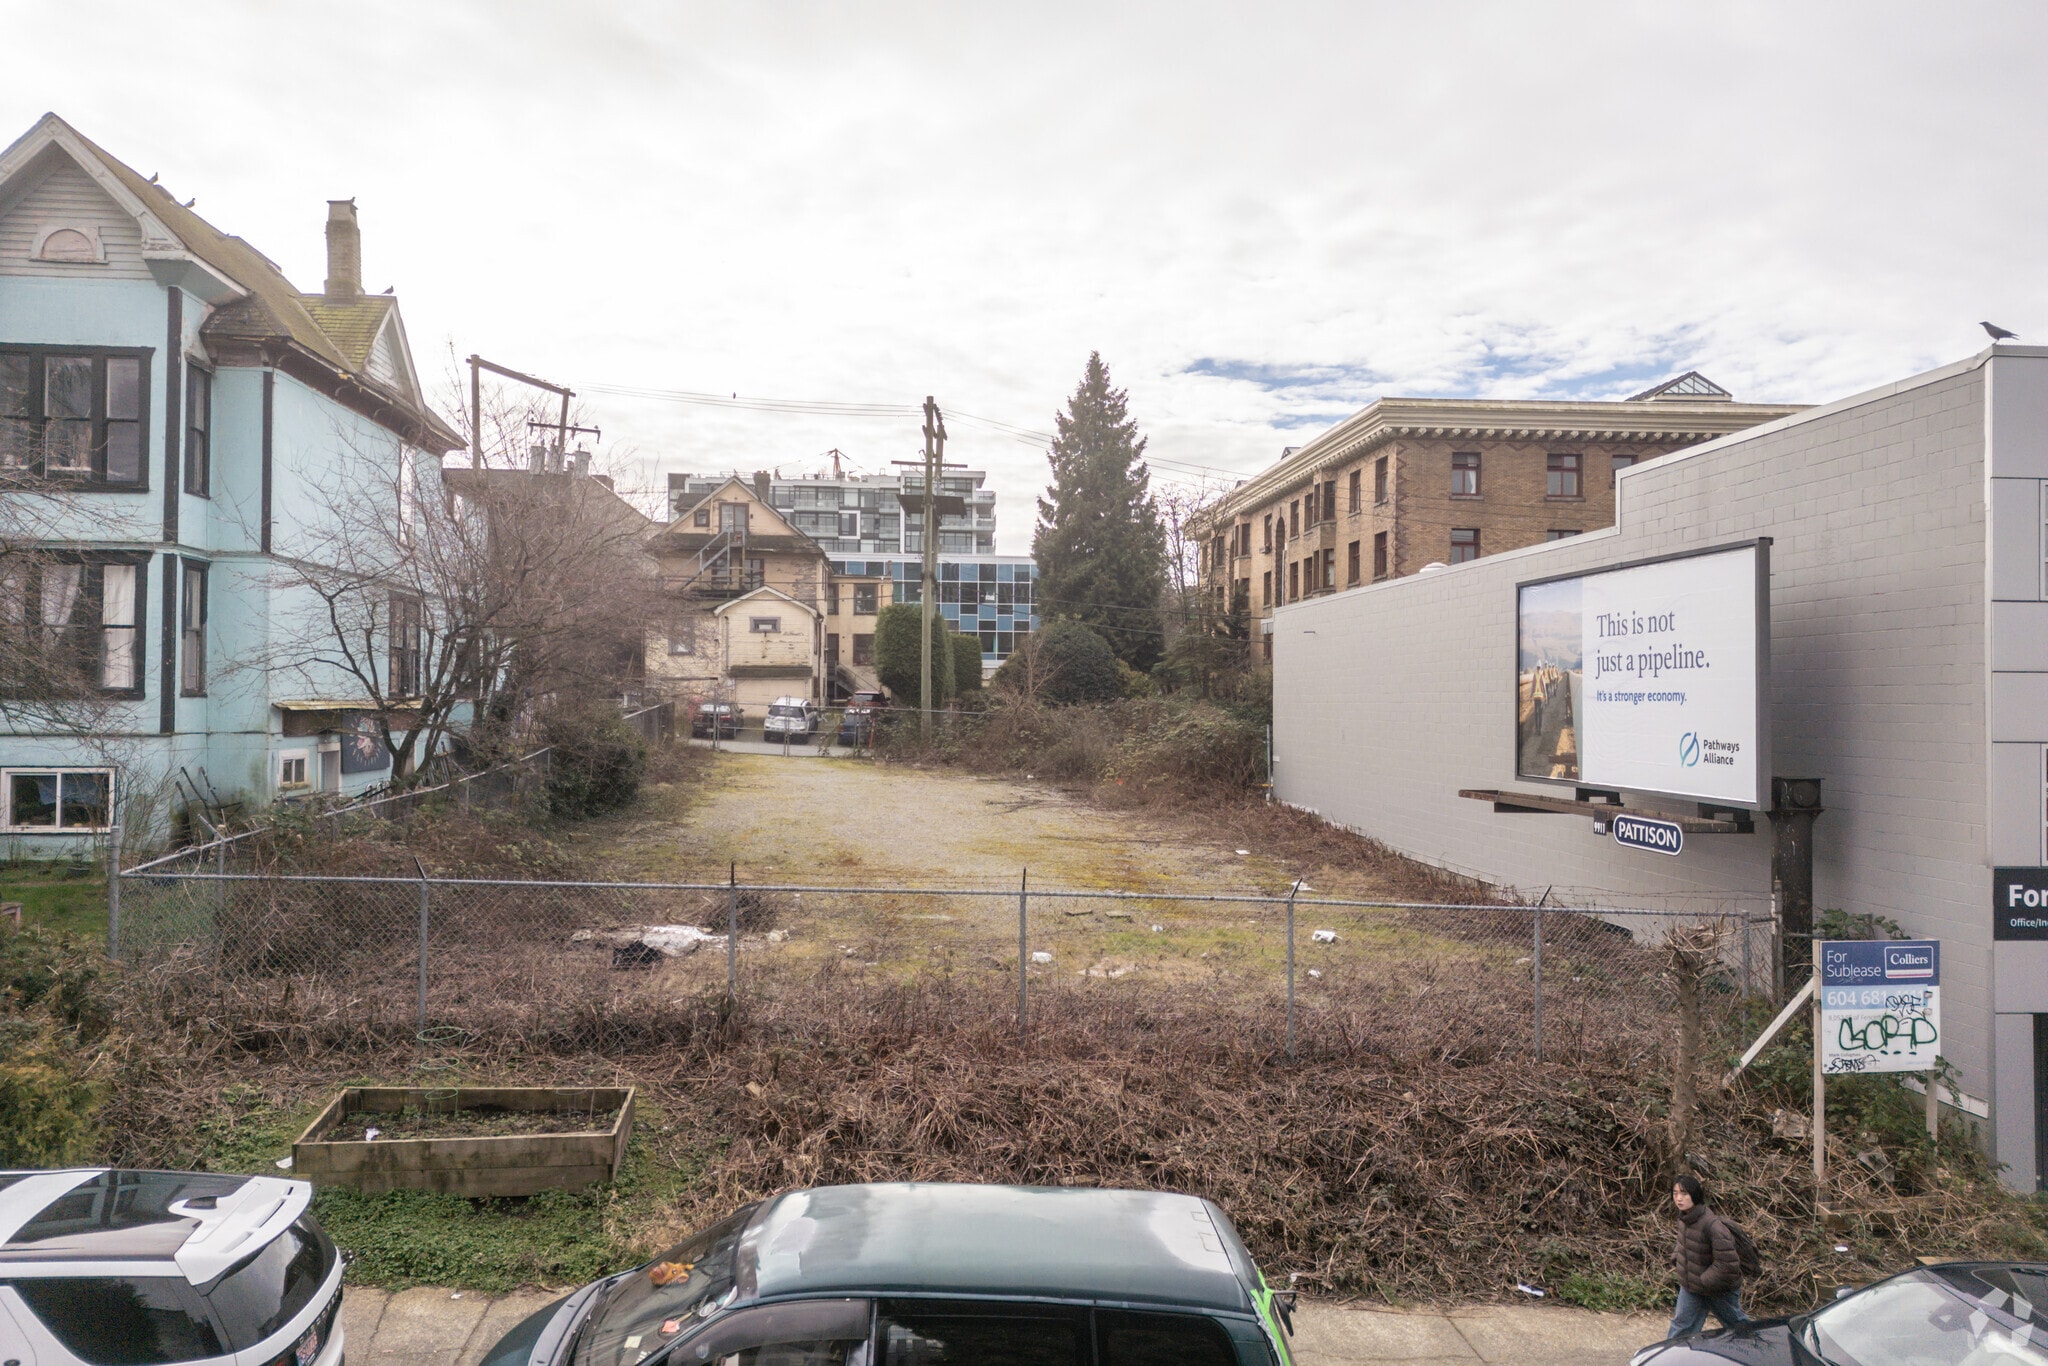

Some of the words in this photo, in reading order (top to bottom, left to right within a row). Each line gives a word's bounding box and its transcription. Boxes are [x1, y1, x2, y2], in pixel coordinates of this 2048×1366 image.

[1596, 612, 1628, 637] This
[1632, 610, 1644, 635] is
[1648, 611, 1675, 633] not
[1595, 649, 1623, 680] just
[1626, 653, 1635, 671] a
[1638, 643, 1710, 679] pipeline.
[1596, 690, 1607, 702] It's
[1614, 691, 1646, 706] stronger
[1647, 692, 1687, 706] economy.
[1703, 739, 1740, 754] Pathways
[1703, 753, 1734, 766] Alliance
[1618, 821, 1677, 849] PATTISON
[2009, 884, 2048, 907] For
[2010, 918, 2048, 929] Office/In
[1827, 950, 1848, 963] For
[1890, 953, 1928, 965] Colliers
[1827, 964, 1881, 978] Sublease
[1827, 991, 1857, 1006] 604
[1861, 990, 1887, 1006] 681
